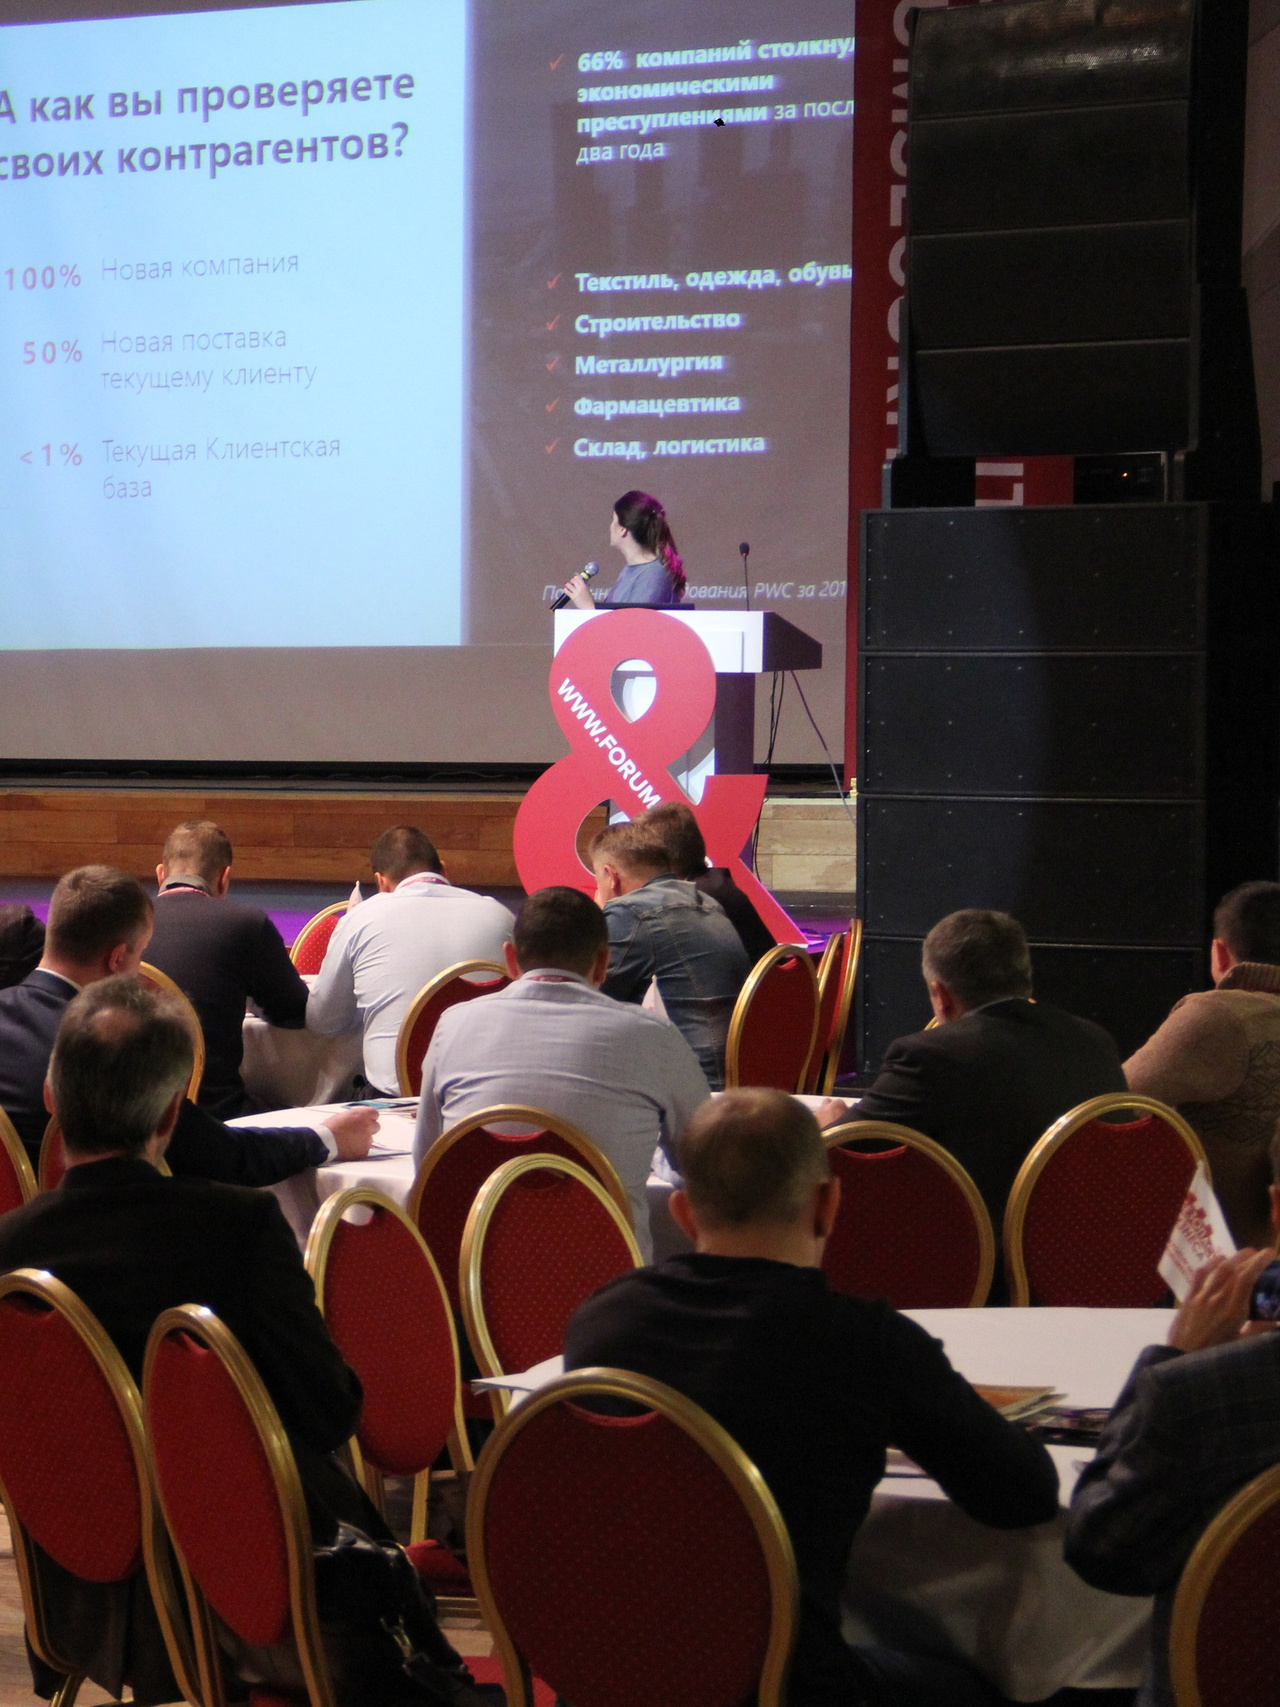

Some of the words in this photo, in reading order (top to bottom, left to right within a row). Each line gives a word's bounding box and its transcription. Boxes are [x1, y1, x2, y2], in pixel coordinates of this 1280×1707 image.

[577, 50, 624, 73] 66%
[635, 40, 753, 69] компаний
[30, 92, 95, 123] как
[109, 90, 162, 118] вы
[177, 72, 415, 122] проверяете
[577, 74, 775, 103] экономическими
[577, 105, 768, 138] преступлениями
[773, 103, 797, 120] за
[118, 122, 409, 179] контрагентов?
[576, 145, 613, 165] два
[619, 141, 665, 163] года
[4, 264, 82, 290] 100%
[101, 257, 173, 282] Новая
[181, 252, 300, 278] компания
[575, 271, 679, 293] Текстиль,
[686, 266, 782, 291] одежда,
[575, 312, 741, 339] Строительство
[23, 340, 83, 365] 50%
[101, 330, 173, 355] Новая
[181, 328, 288, 353] поставка
[101, 367, 214, 393] текущему
[221, 363, 319, 390] клиенту
[575, 355, 725, 378] Металлургия
[574, 395, 741, 421] Фармацевтика
[102, 438, 197, 466] Текущая
[206, 436, 341, 461] Клиентская
[574, 437, 647, 460] Склад,
[653, 435, 766, 458] логистика
[102, 475, 153, 500] база
[754, 582, 795, 599] PWC
[797, 584, 816, 599] за
